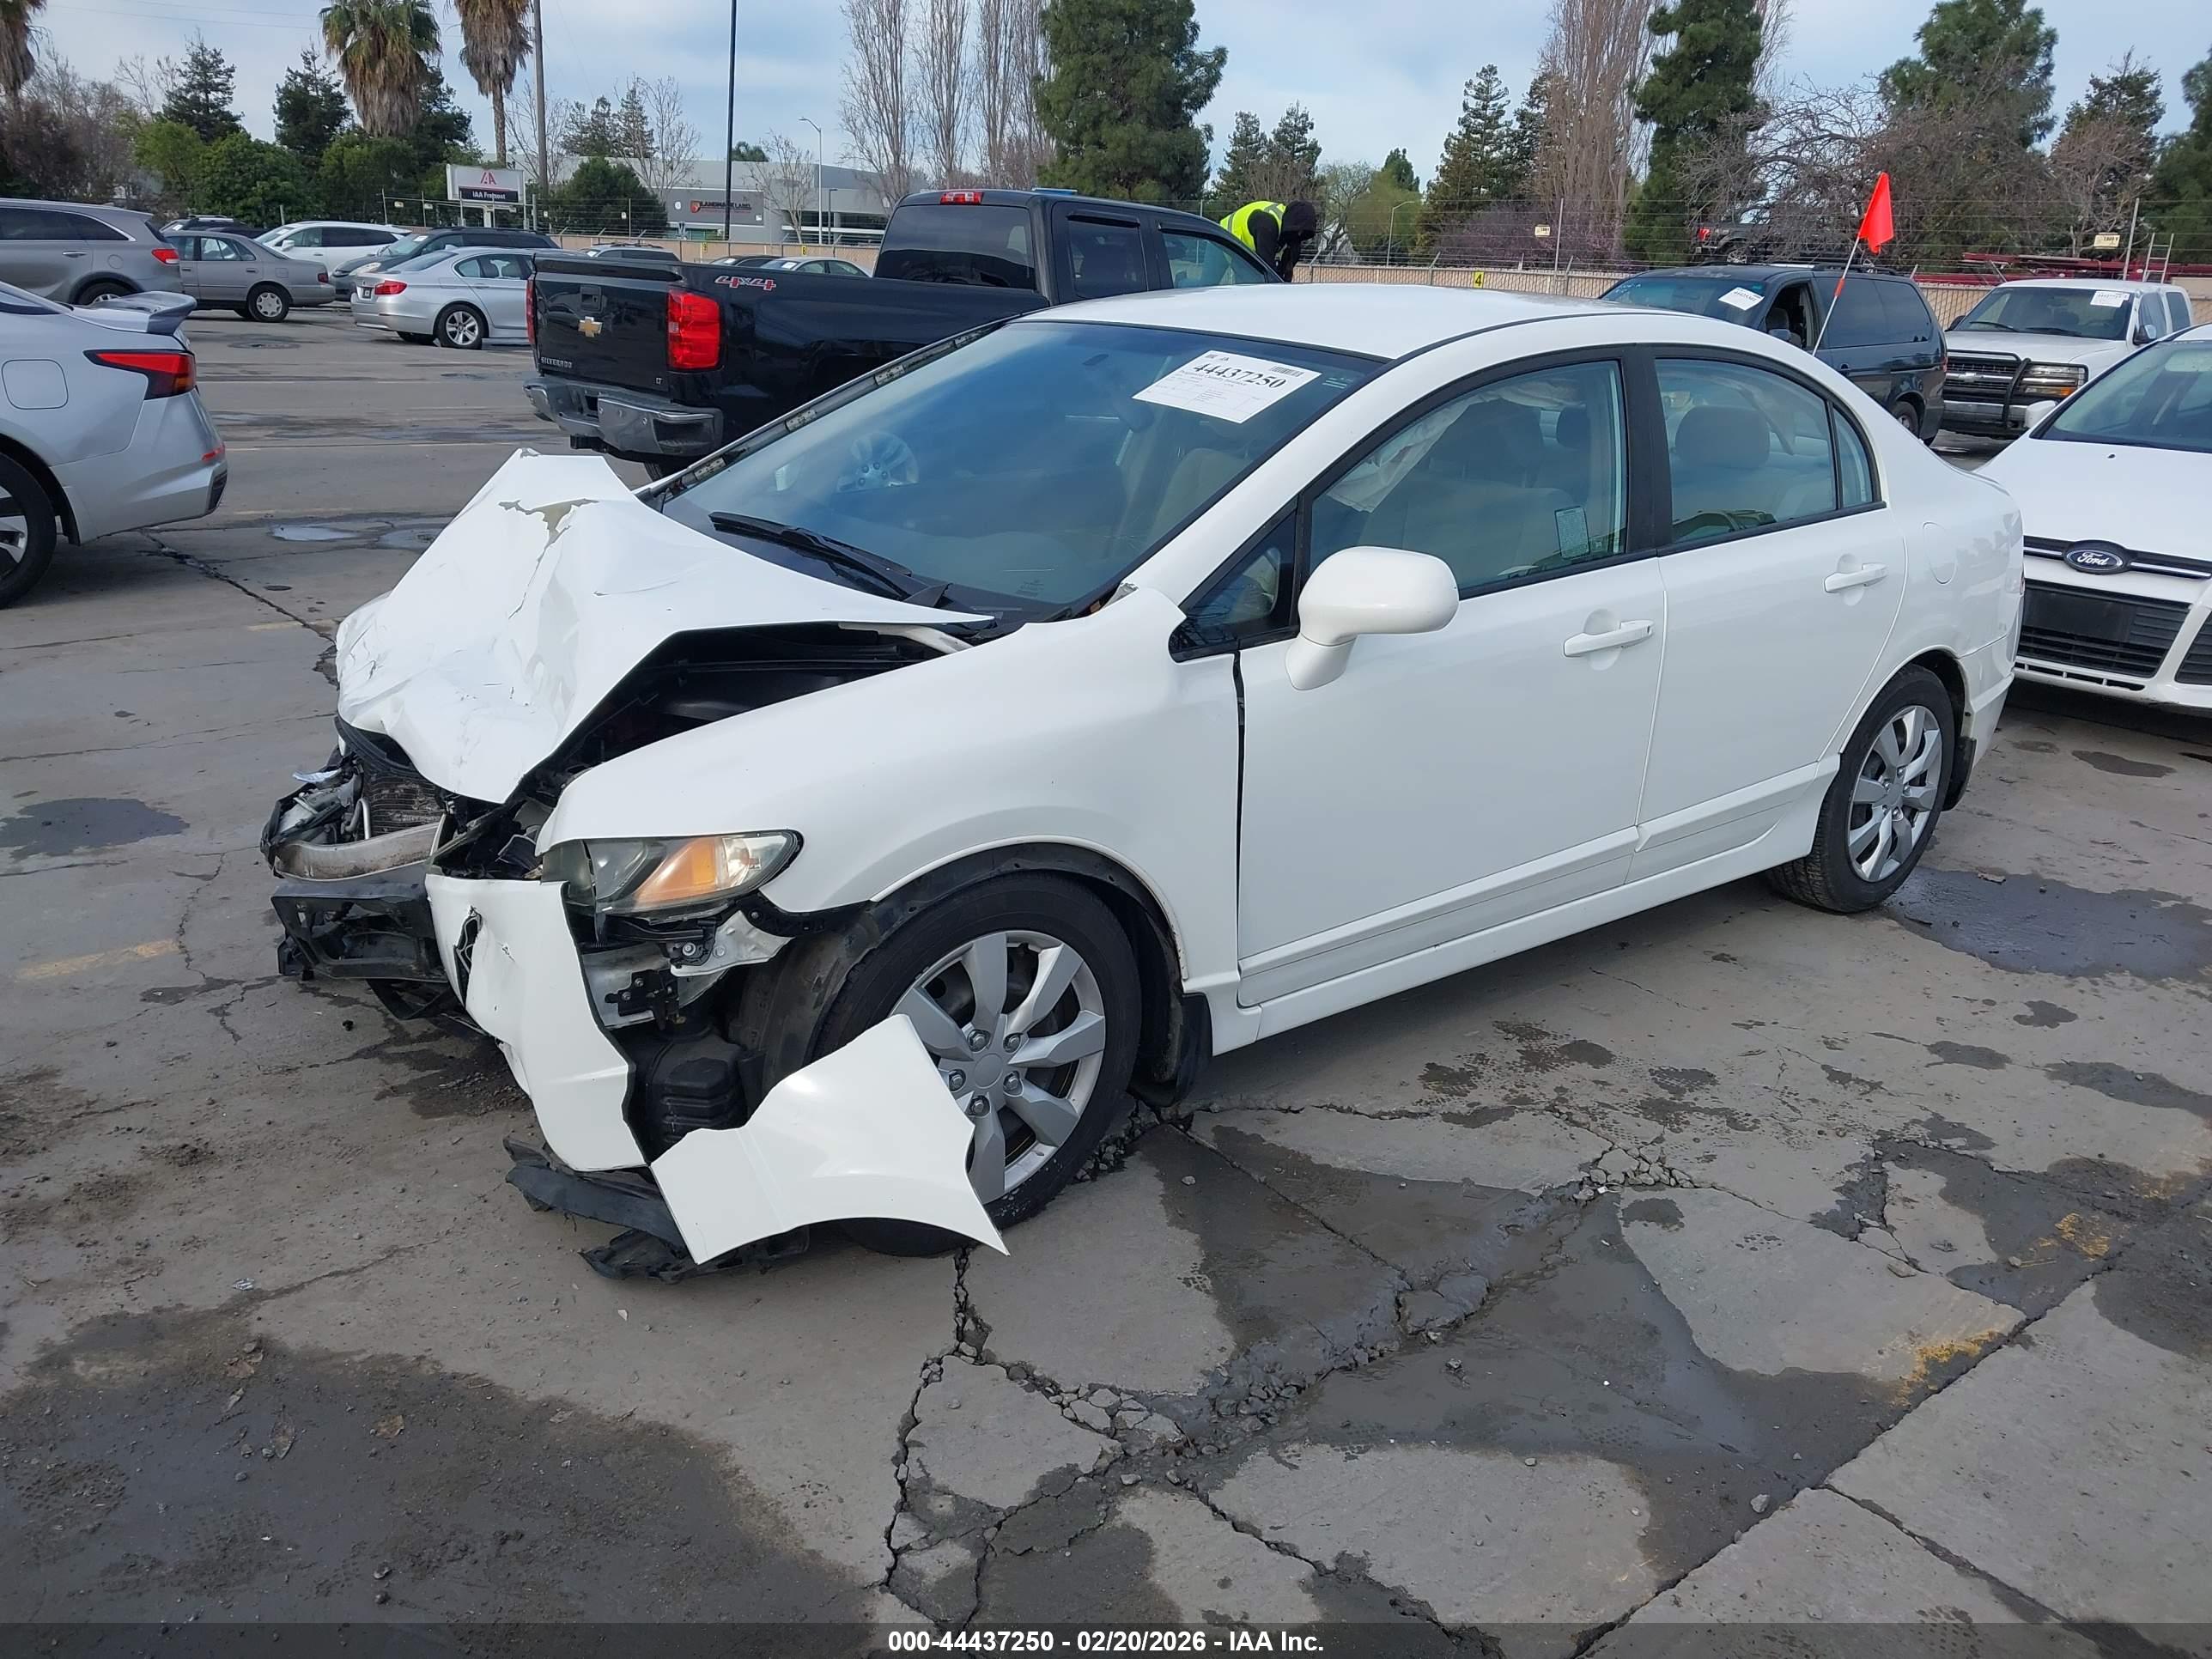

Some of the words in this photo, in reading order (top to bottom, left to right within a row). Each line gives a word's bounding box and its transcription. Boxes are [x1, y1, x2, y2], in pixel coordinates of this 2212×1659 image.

[1474, 274, 1482, 287] 4
[540, 356, 573, 369] SILVERADO
[1193, 363, 1287, 389] 44437250
[2076, 551, 2110, 566] Ford
